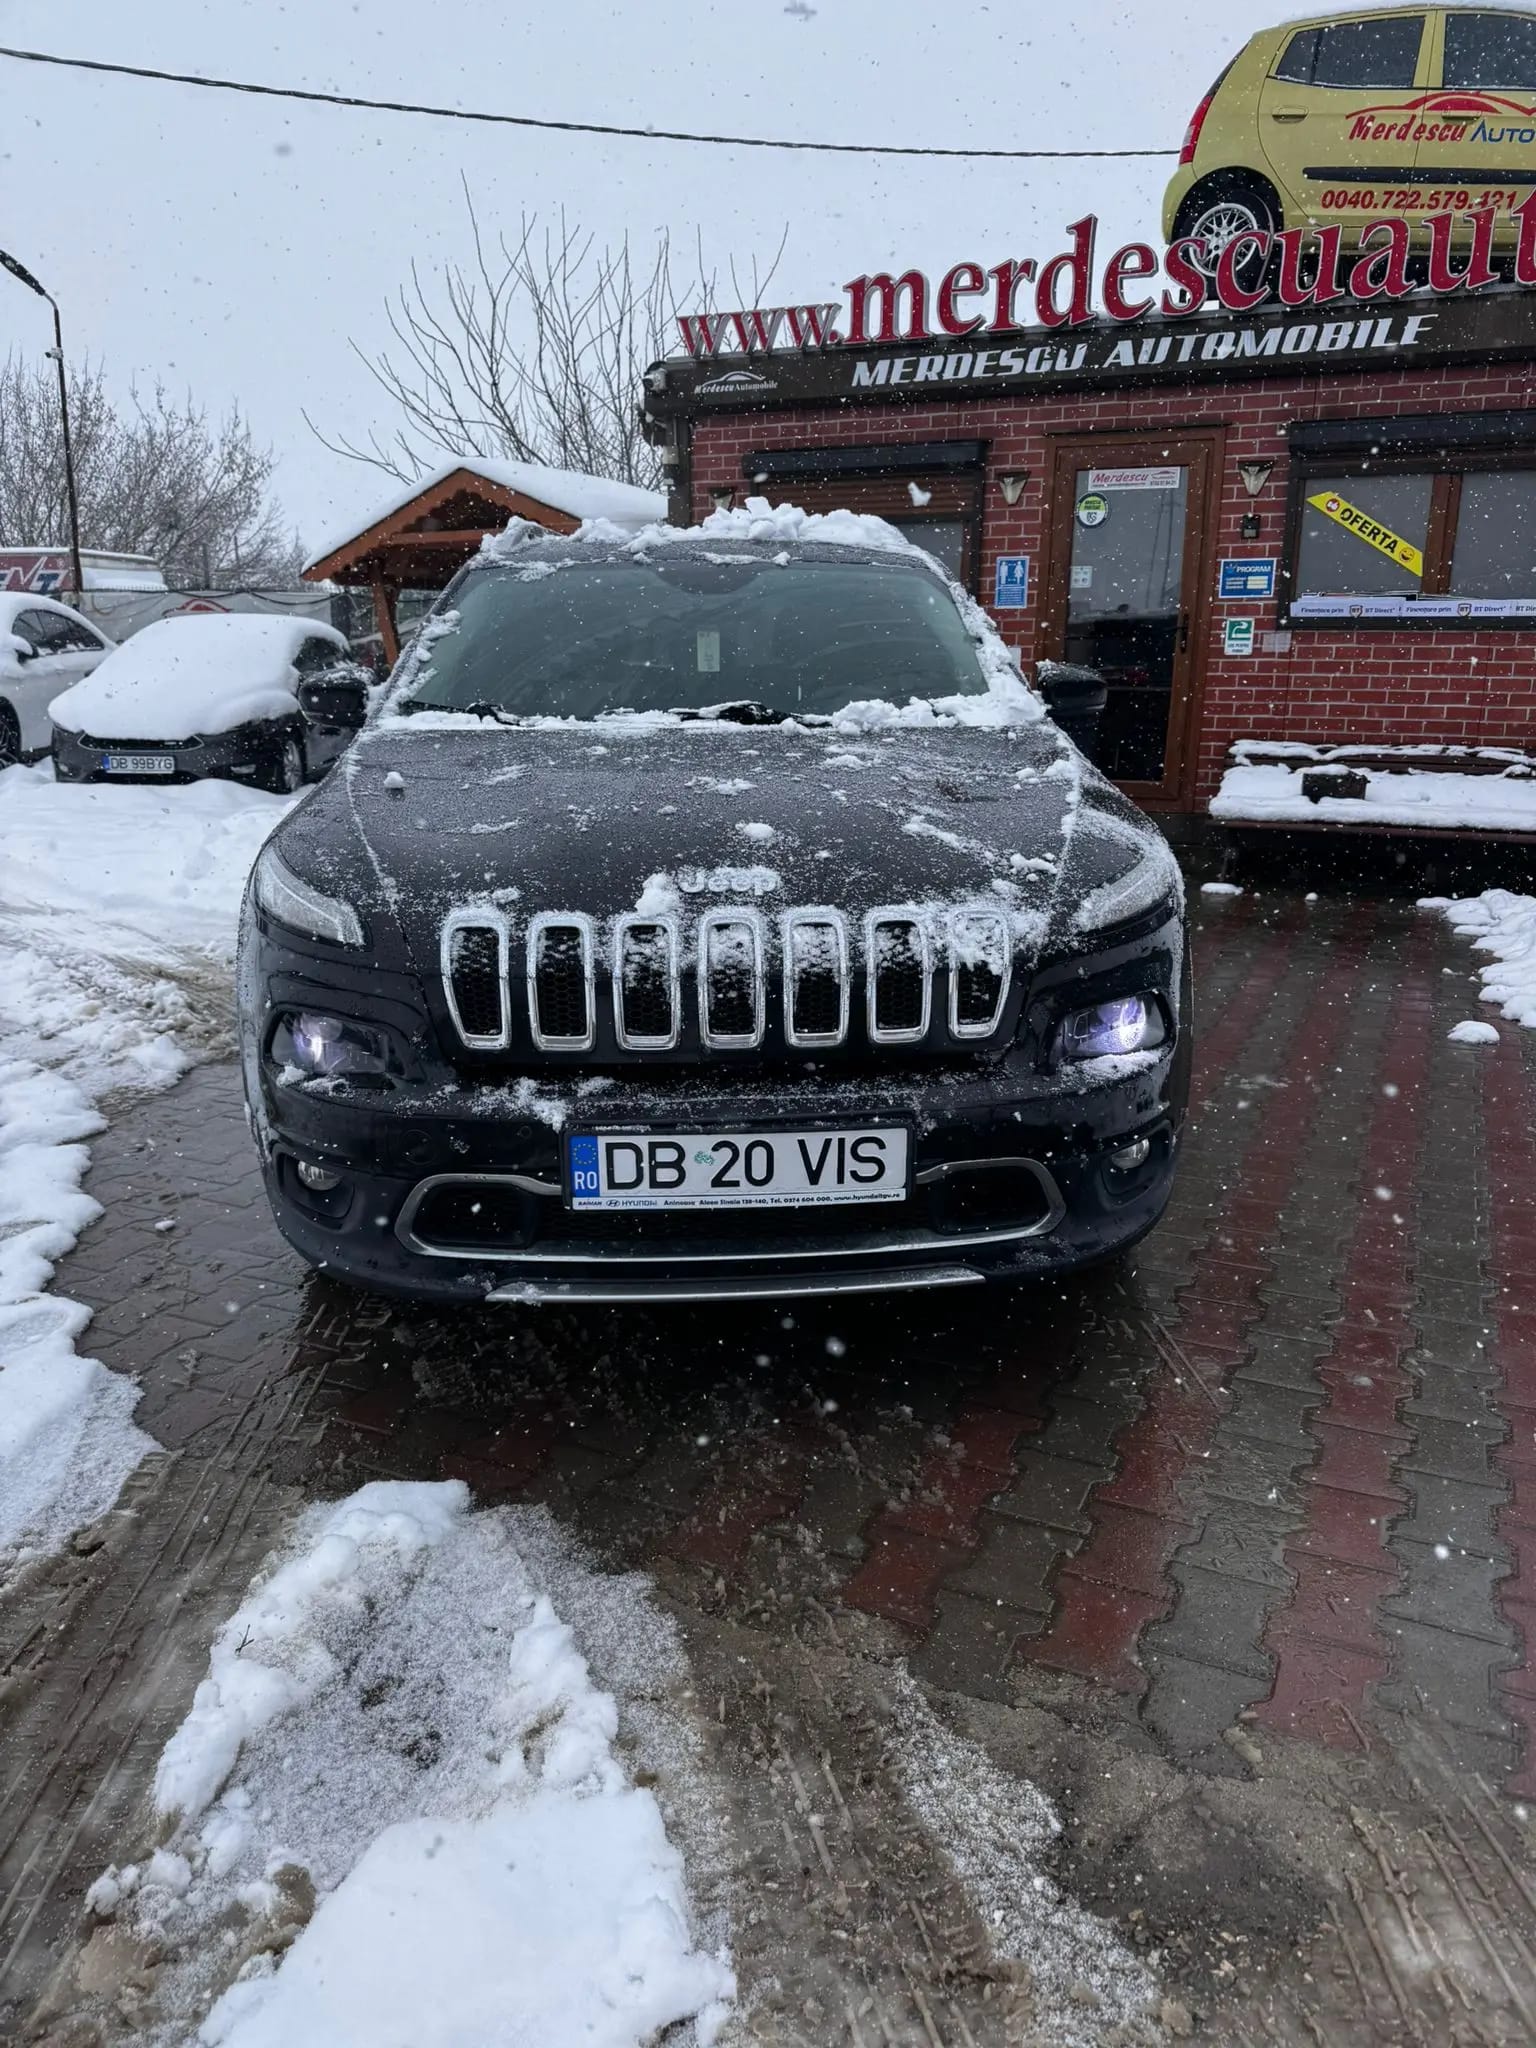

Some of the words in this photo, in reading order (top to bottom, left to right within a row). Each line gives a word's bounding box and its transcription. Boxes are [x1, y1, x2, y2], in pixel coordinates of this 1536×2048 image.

[1349, 114, 1467, 143] Merdescu
[851, 343, 1087, 388] MERDESCU
[1092, 472, 1149, 484] Merdescu
[1340, 507, 1399, 554] OFERTA
[1236, 565, 1271, 573] PROGRAM
[111, 757, 128, 769] DB
[677, 866, 783, 896] Jeep
[604, 1141, 687, 1190] DB
[710, 1139, 775, 1188] 20
[797, 1136, 887, 1186] VIS
[574, 1171, 598, 1190] RO
